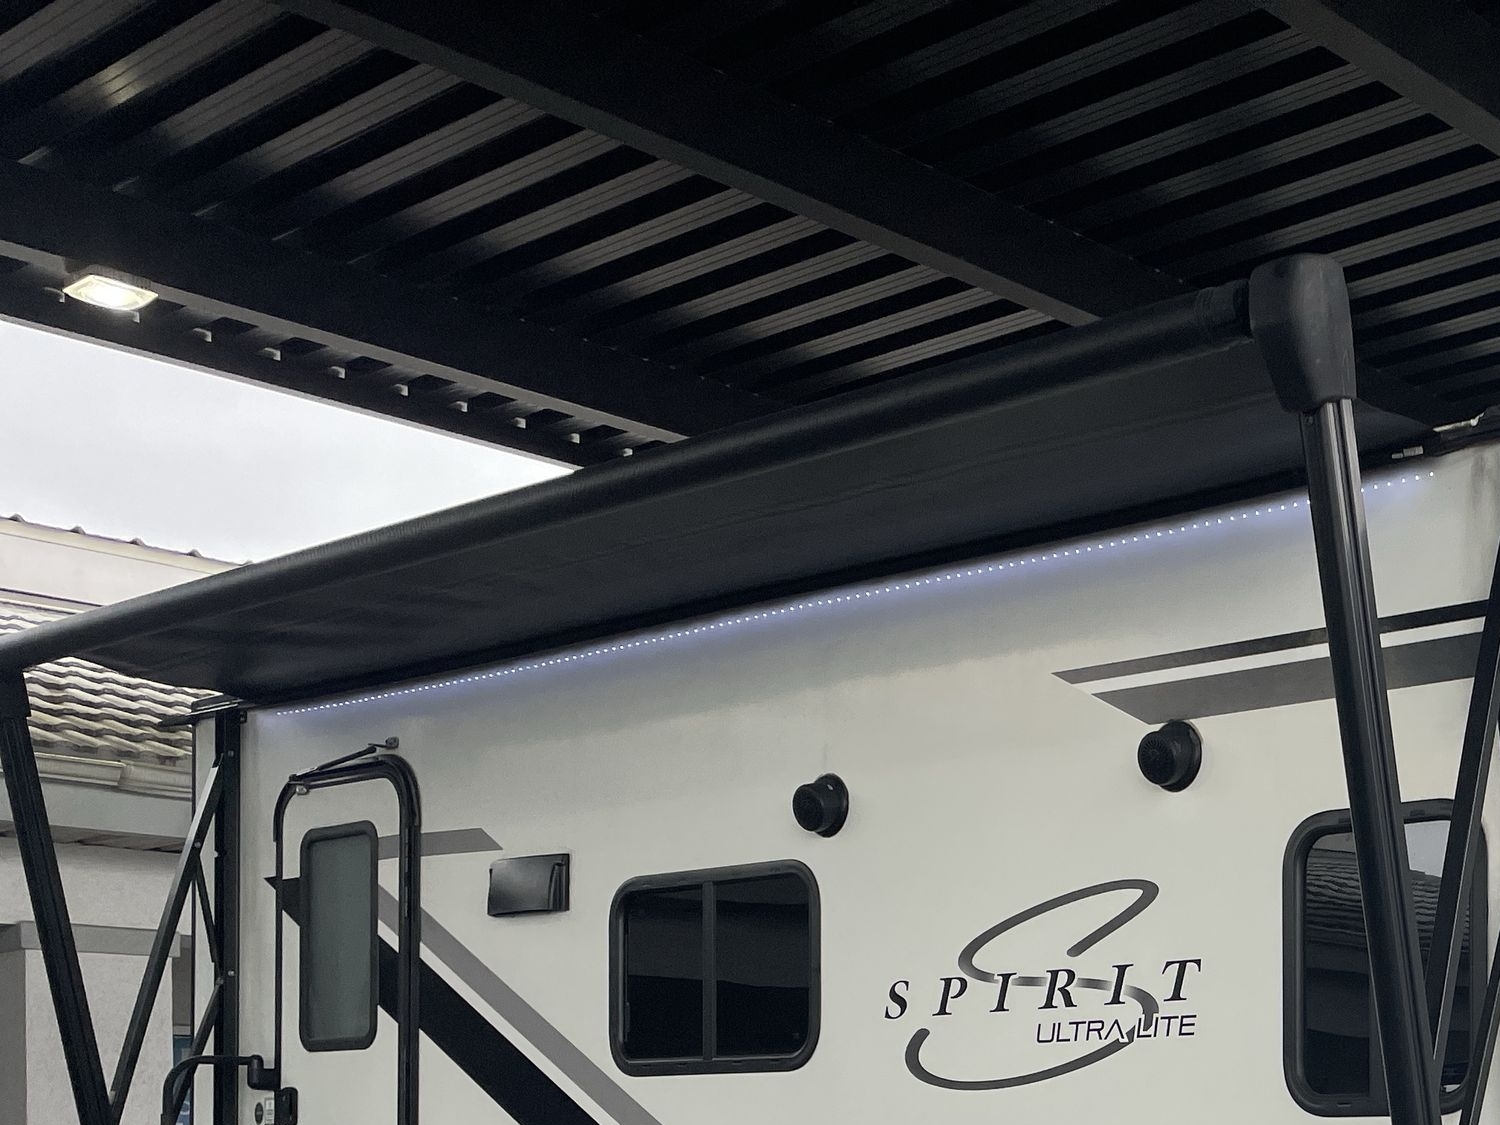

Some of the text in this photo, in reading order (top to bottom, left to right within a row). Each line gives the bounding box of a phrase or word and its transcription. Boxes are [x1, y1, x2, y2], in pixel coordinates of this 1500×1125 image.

[884, 957, 1203, 1021] SPIRIT
[1036, 1015, 1198, 1044] ULTRA LITE
